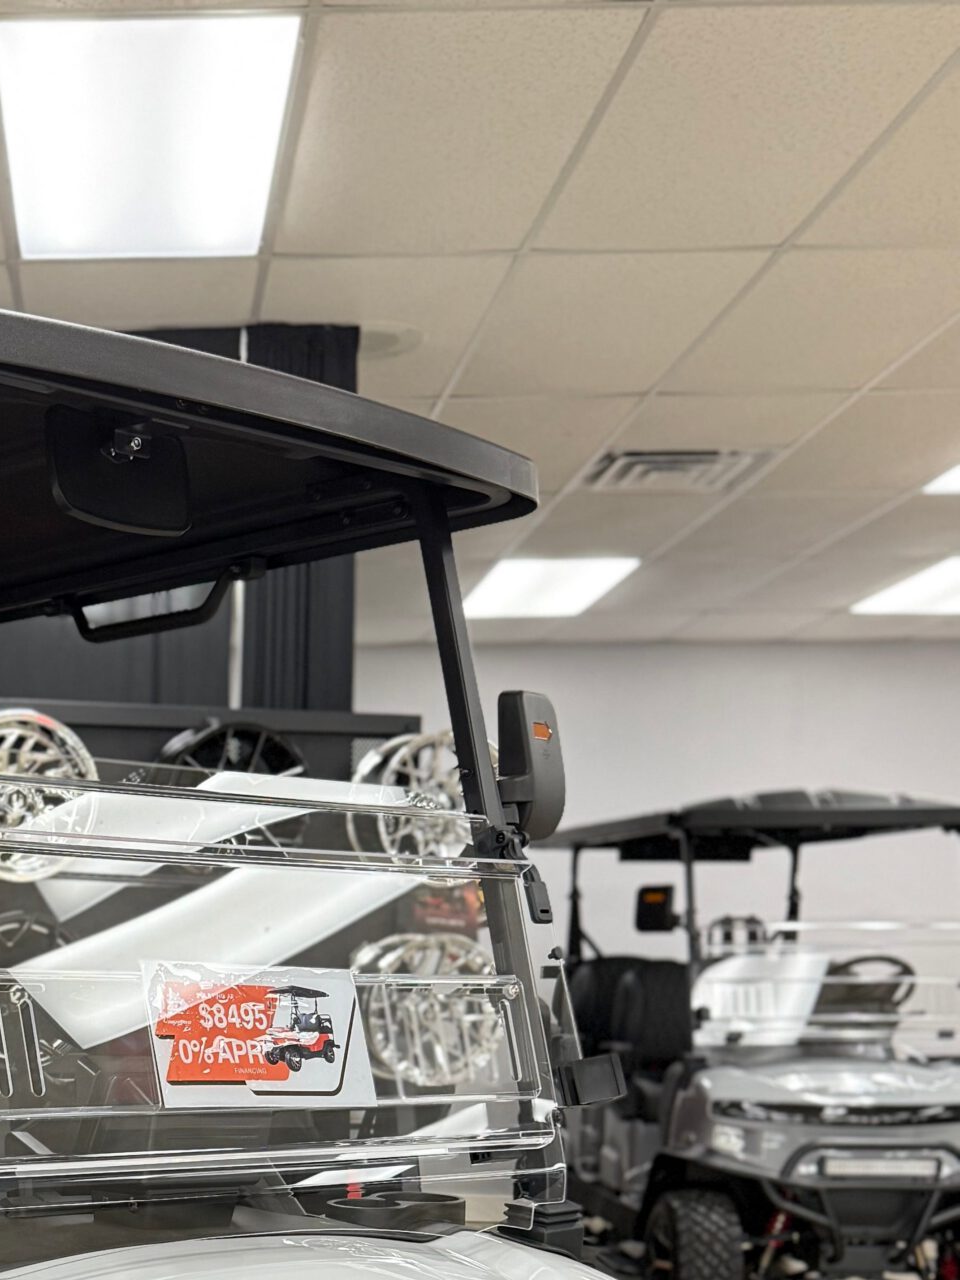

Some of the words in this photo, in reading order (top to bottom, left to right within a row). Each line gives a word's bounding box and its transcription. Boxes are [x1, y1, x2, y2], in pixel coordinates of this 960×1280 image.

[198, 1002, 268, 1031] $8495
[178, 1037, 214, 1064] 0%
[217, 1038, 265, 1064] APR
[234, 1067, 267, 1075] FINANCING
